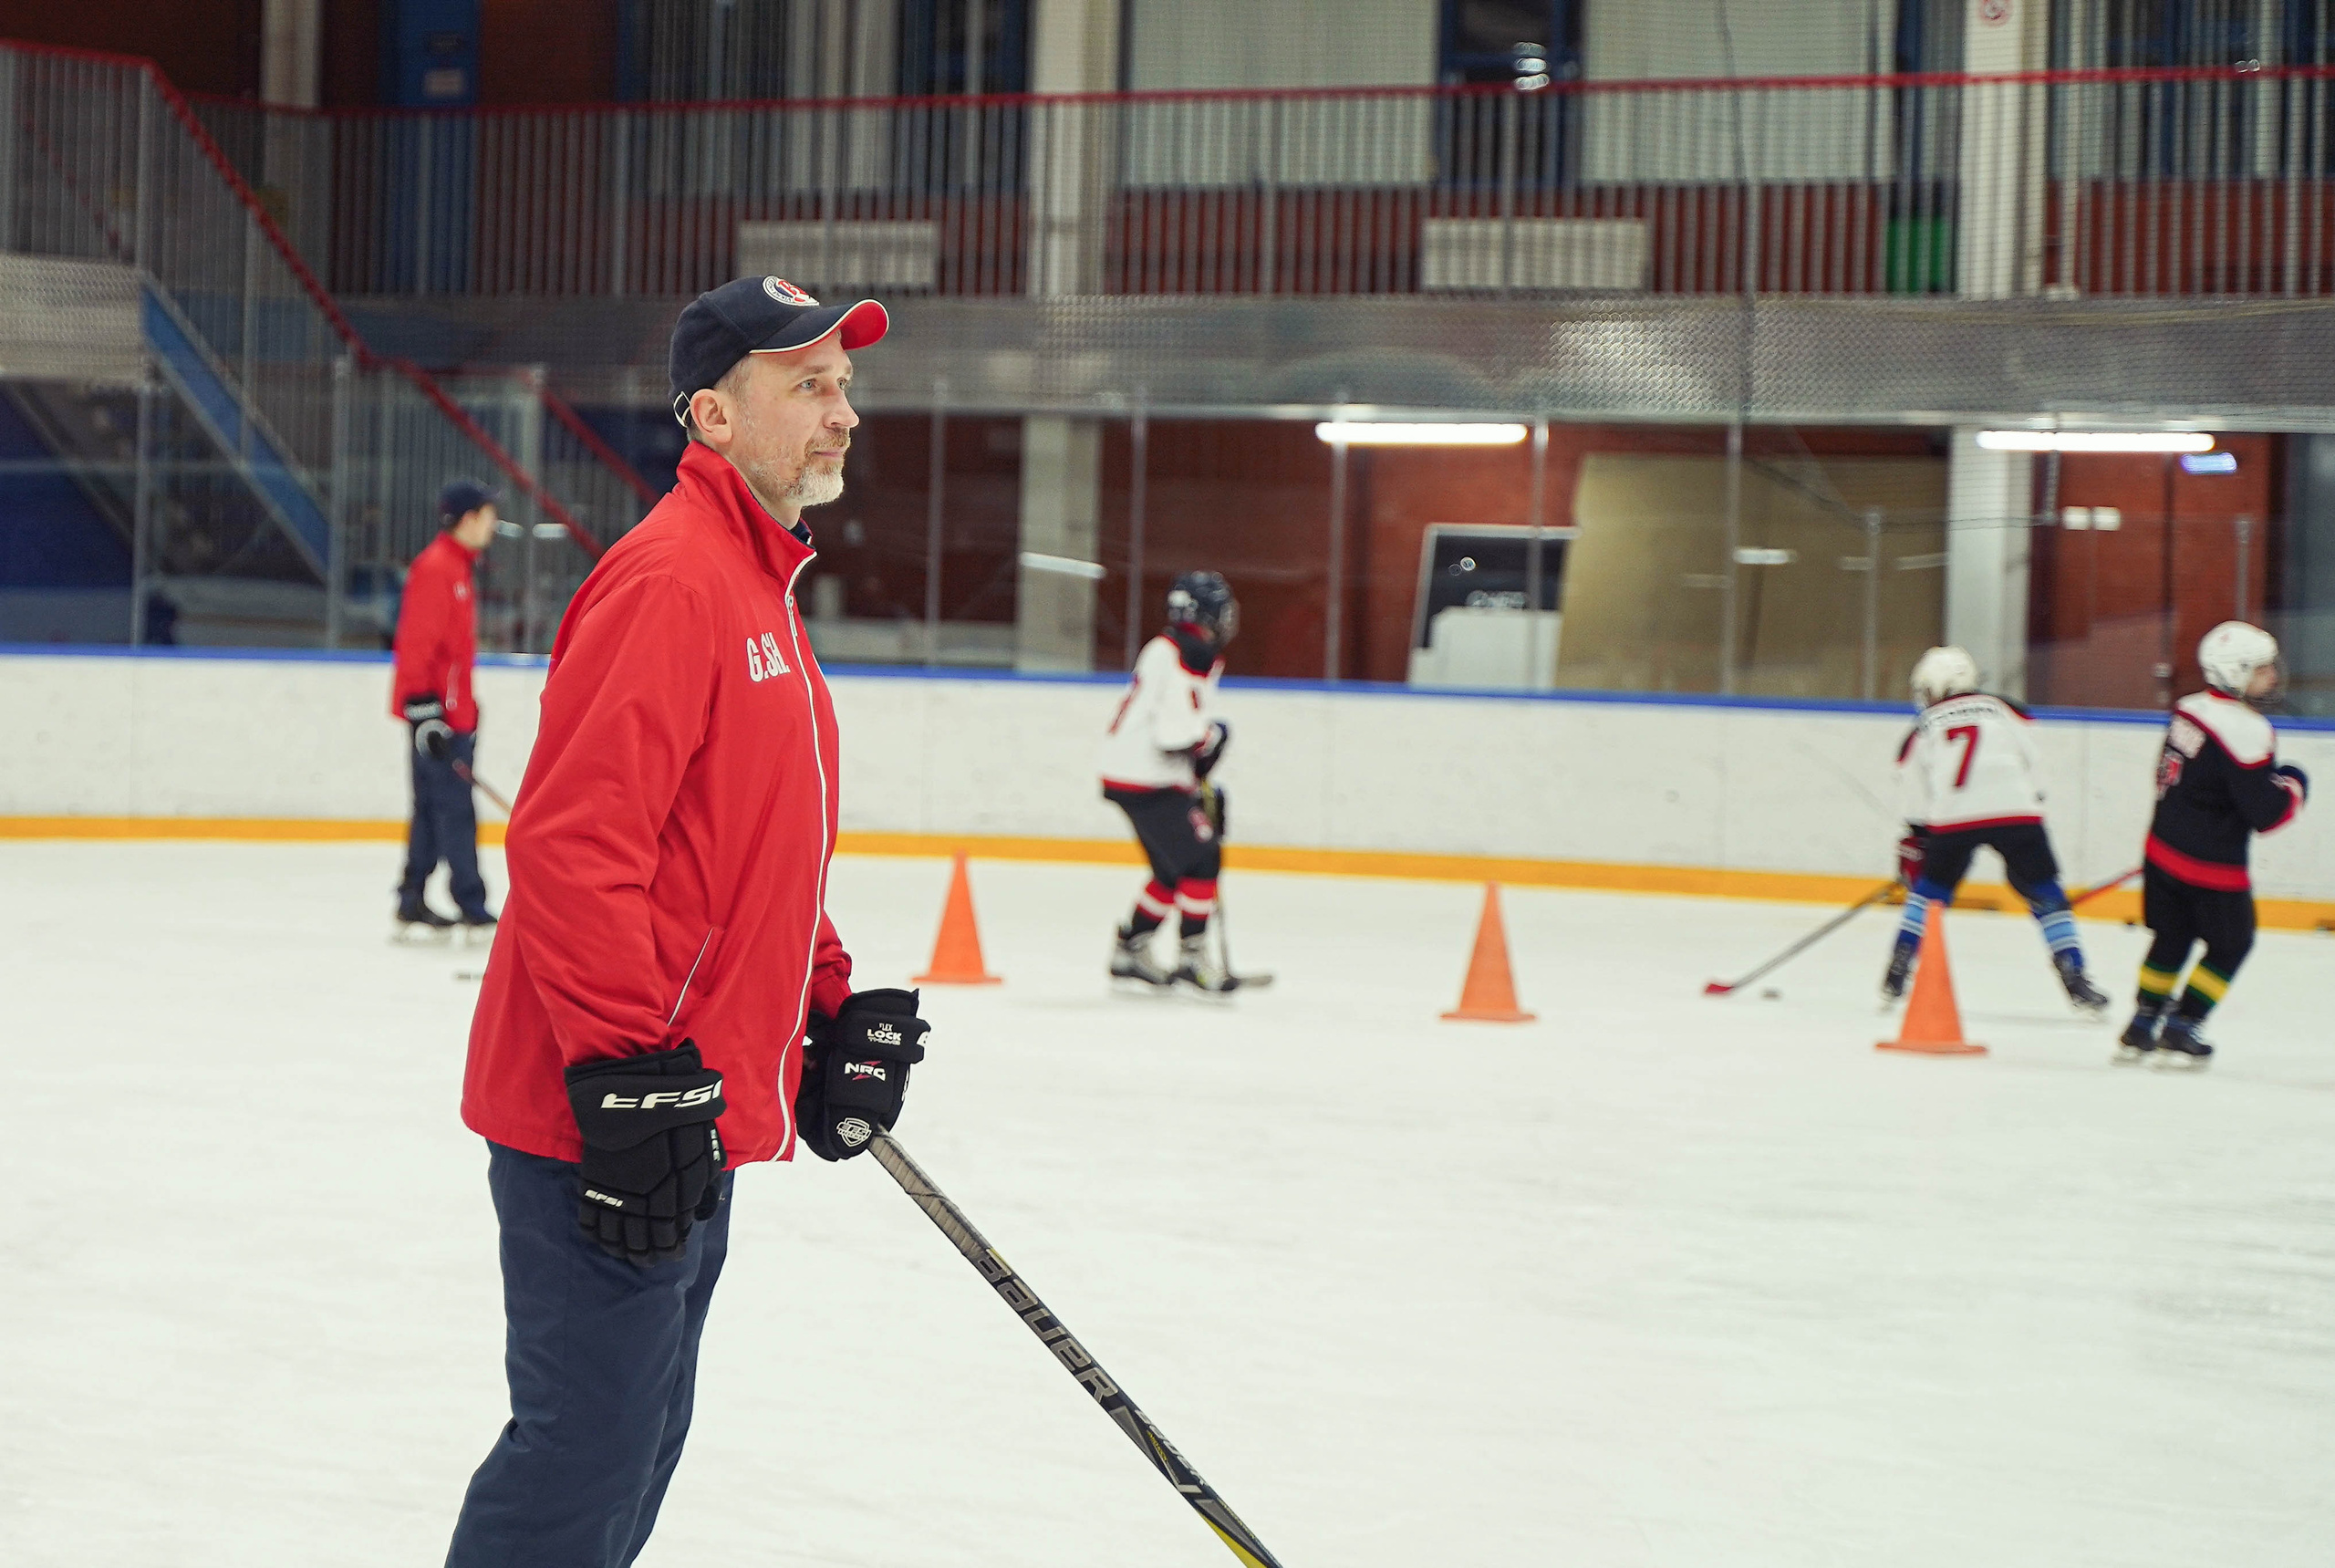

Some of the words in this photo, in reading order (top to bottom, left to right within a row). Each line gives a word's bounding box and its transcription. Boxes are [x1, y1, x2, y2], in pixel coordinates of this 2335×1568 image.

[1946, 724, 1979, 787] 7
[867, 1029, 902, 1041] LOCK
[844, 1062, 887, 1082] NRG
[977, 1247, 1120, 1404] BAUER
